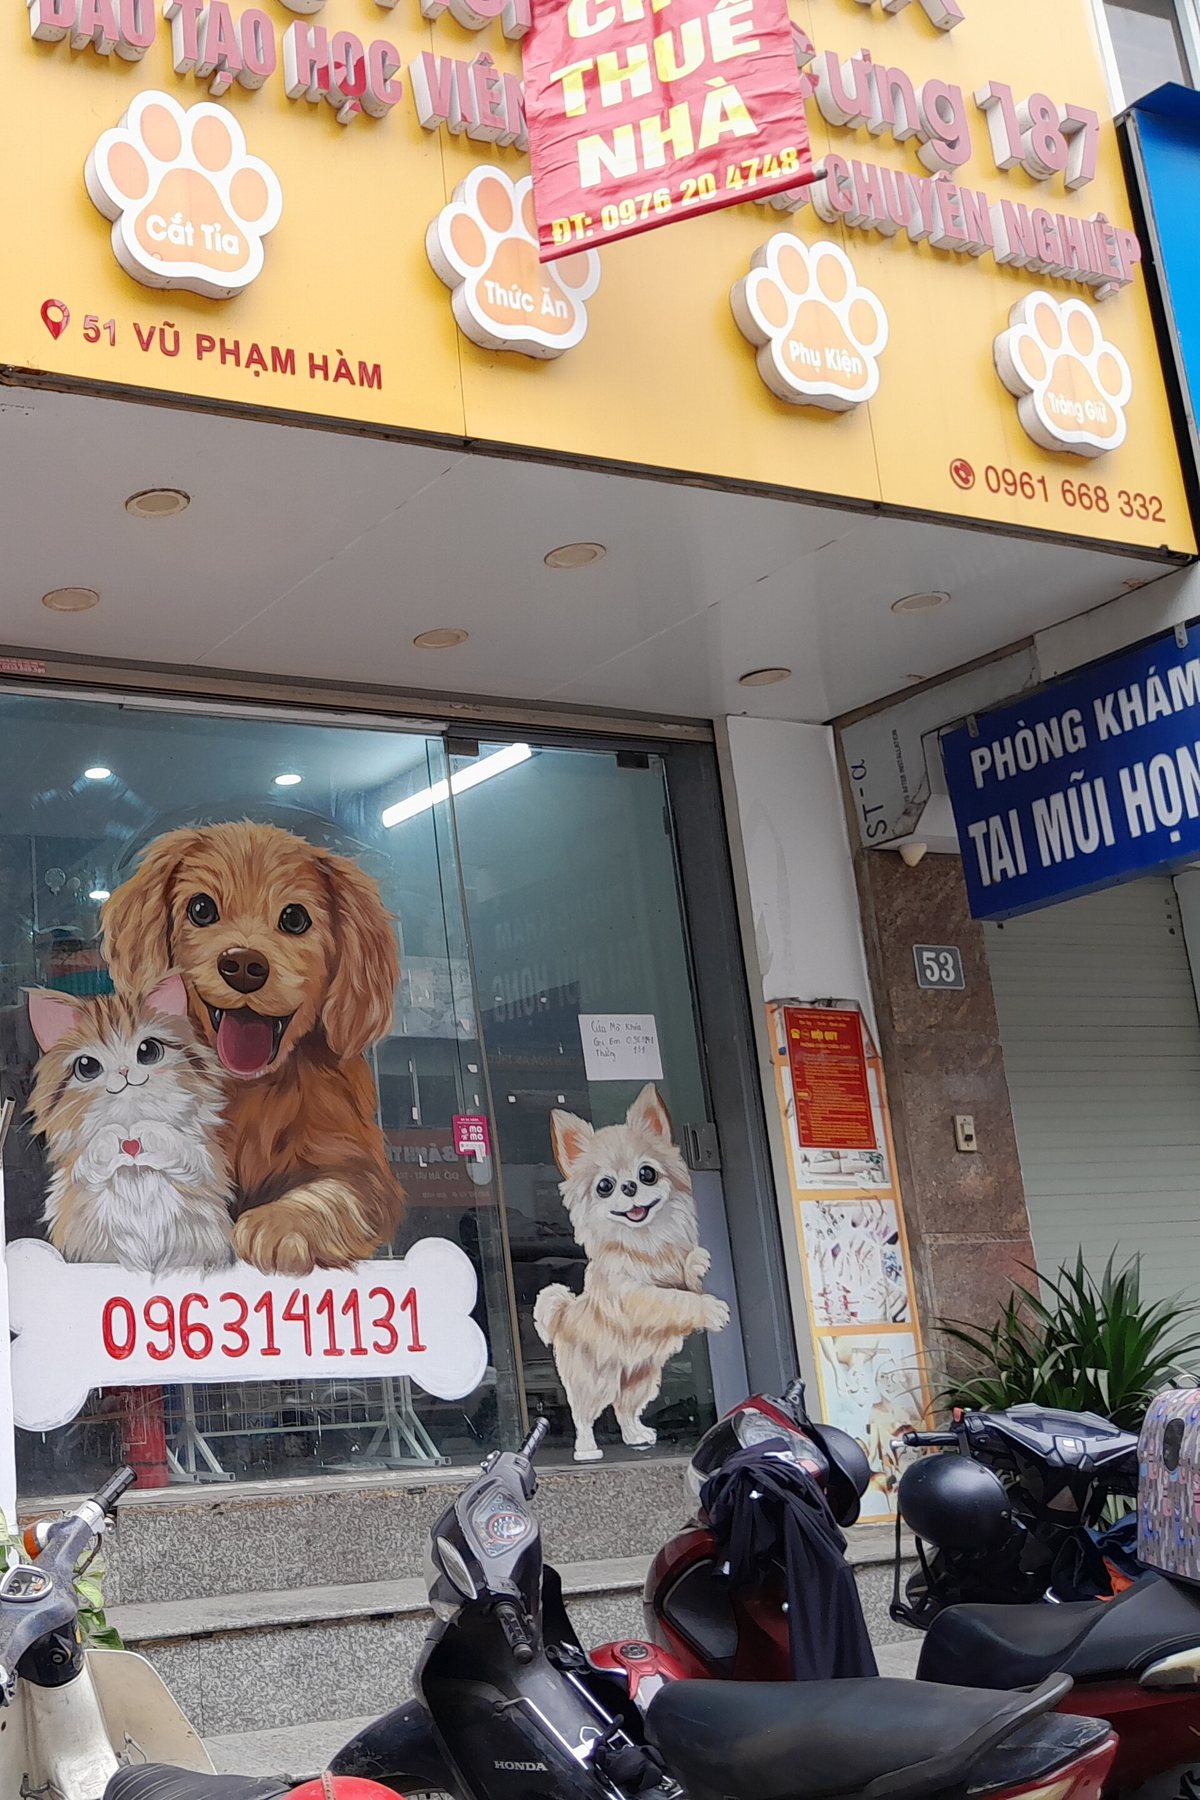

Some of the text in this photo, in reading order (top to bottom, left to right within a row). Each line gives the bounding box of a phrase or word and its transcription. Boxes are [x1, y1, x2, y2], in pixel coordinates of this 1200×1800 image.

[283, 19, 403, 126] HỌC
[577, 76, 758, 188] NHÀ
[974, 80, 1100, 190] 187
[601, 187, 673, 231] 0976
[680, 172, 717, 206] 20
[726, 147, 800, 190] 4748
[812, 153, 1142, 300] CHUYÊN NGHIỆP
[146, 212, 240, 255] Cắt Tỉa
[483, 280, 568, 319] Thức Ăn
[83, 314, 383, 390] 51 VŨ PHẠM HÀM
[789, 340, 822, 373] Phụ
[985, 465, 1167, 522] 0961 668 332
[969, 657, 1200, 789] PHÒNG KHÁM
[967, 810, 1028, 888] TAI
[1031, 769, 1115, 868] MŨI
[921, 951, 956, 983] 53
[101, 1286, 428, 1360] 0963141131
[494, 1760, 549, 1772] HONDA
